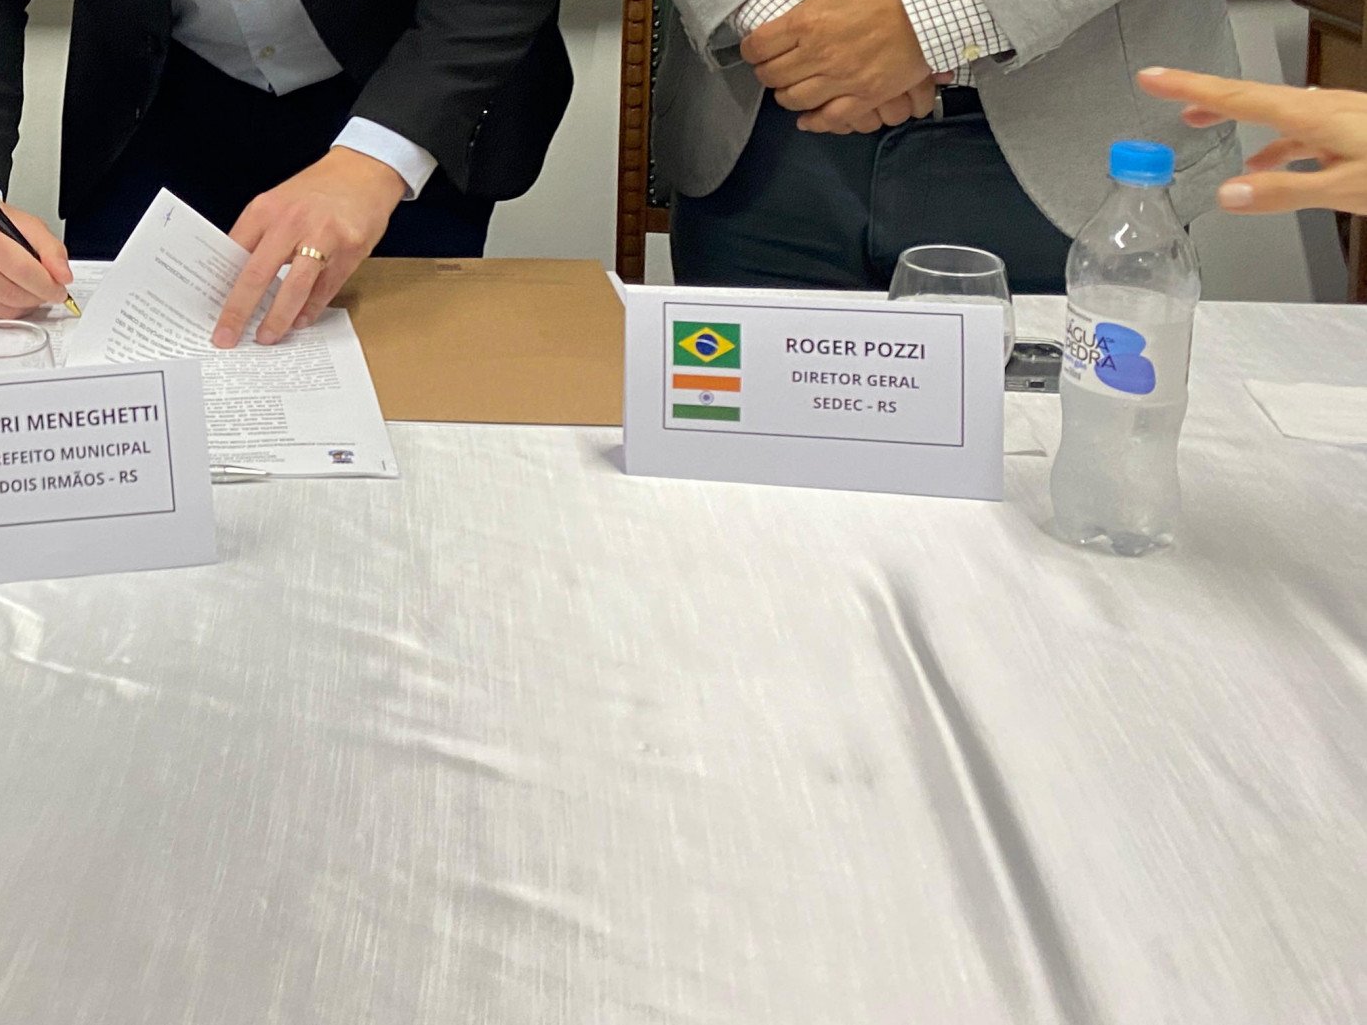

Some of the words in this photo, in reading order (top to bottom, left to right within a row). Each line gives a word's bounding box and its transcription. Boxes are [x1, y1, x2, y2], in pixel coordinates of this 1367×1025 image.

[786, 338, 857, 356] ROGER
[864, 341, 925, 359] POZZI
[1065, 337, 1116, 370] PEDRA
[792, 370, 862, 386] DIRETOR
[867, 374, 920, 389] GERAL
[813, 397, 863, 411] SEDEC
[878, 400, 897, 413] RS
[27, 404, 159, 431] MENEGHETTI
[60, 440, 151, 461] MUNICIPAL
[0, 478, 37, 494] DOIS
[42, 470, 105, 491] IRMÃOS
[119, 469, 138, 484] RS
